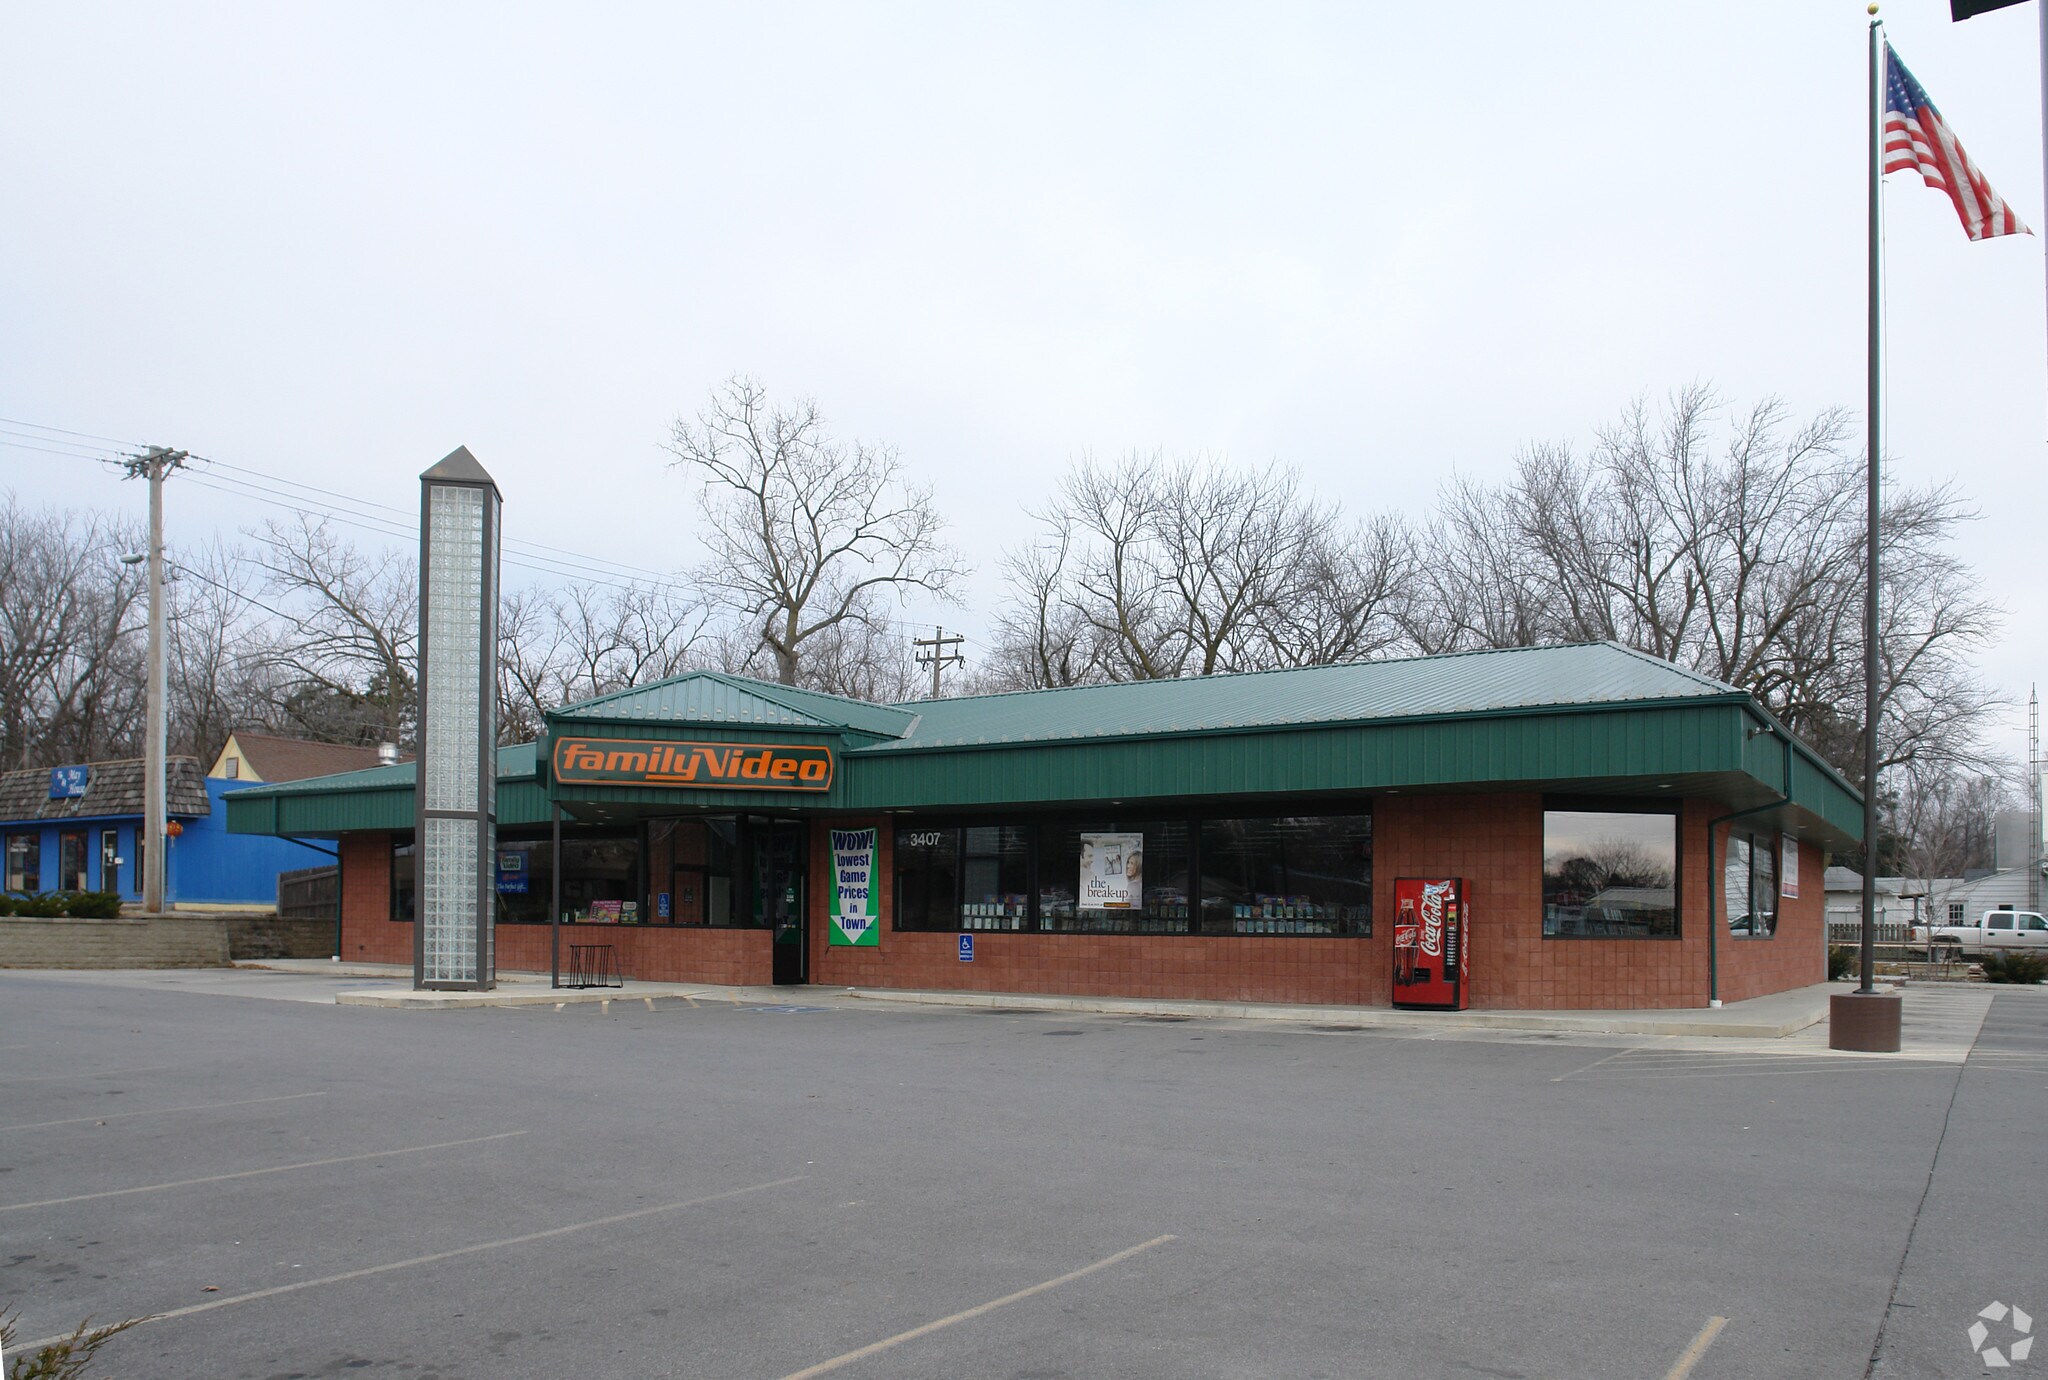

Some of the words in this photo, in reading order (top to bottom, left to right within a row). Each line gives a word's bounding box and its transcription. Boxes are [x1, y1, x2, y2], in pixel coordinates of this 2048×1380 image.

[832, 830, 874, 850] WOW!
[910, 832, 941, 847] 3407
[837, 853, 870, 867] Lowest
[840, 869, 866, 883] Game
[1090, 876, 1106, 888] the
[838, 886, 869, 899] Prices
[1087, 885, 1129, 902] break-up
[849, 902, 858, 914] in
[1420, 893, 1443, 957] Coca-Cola
